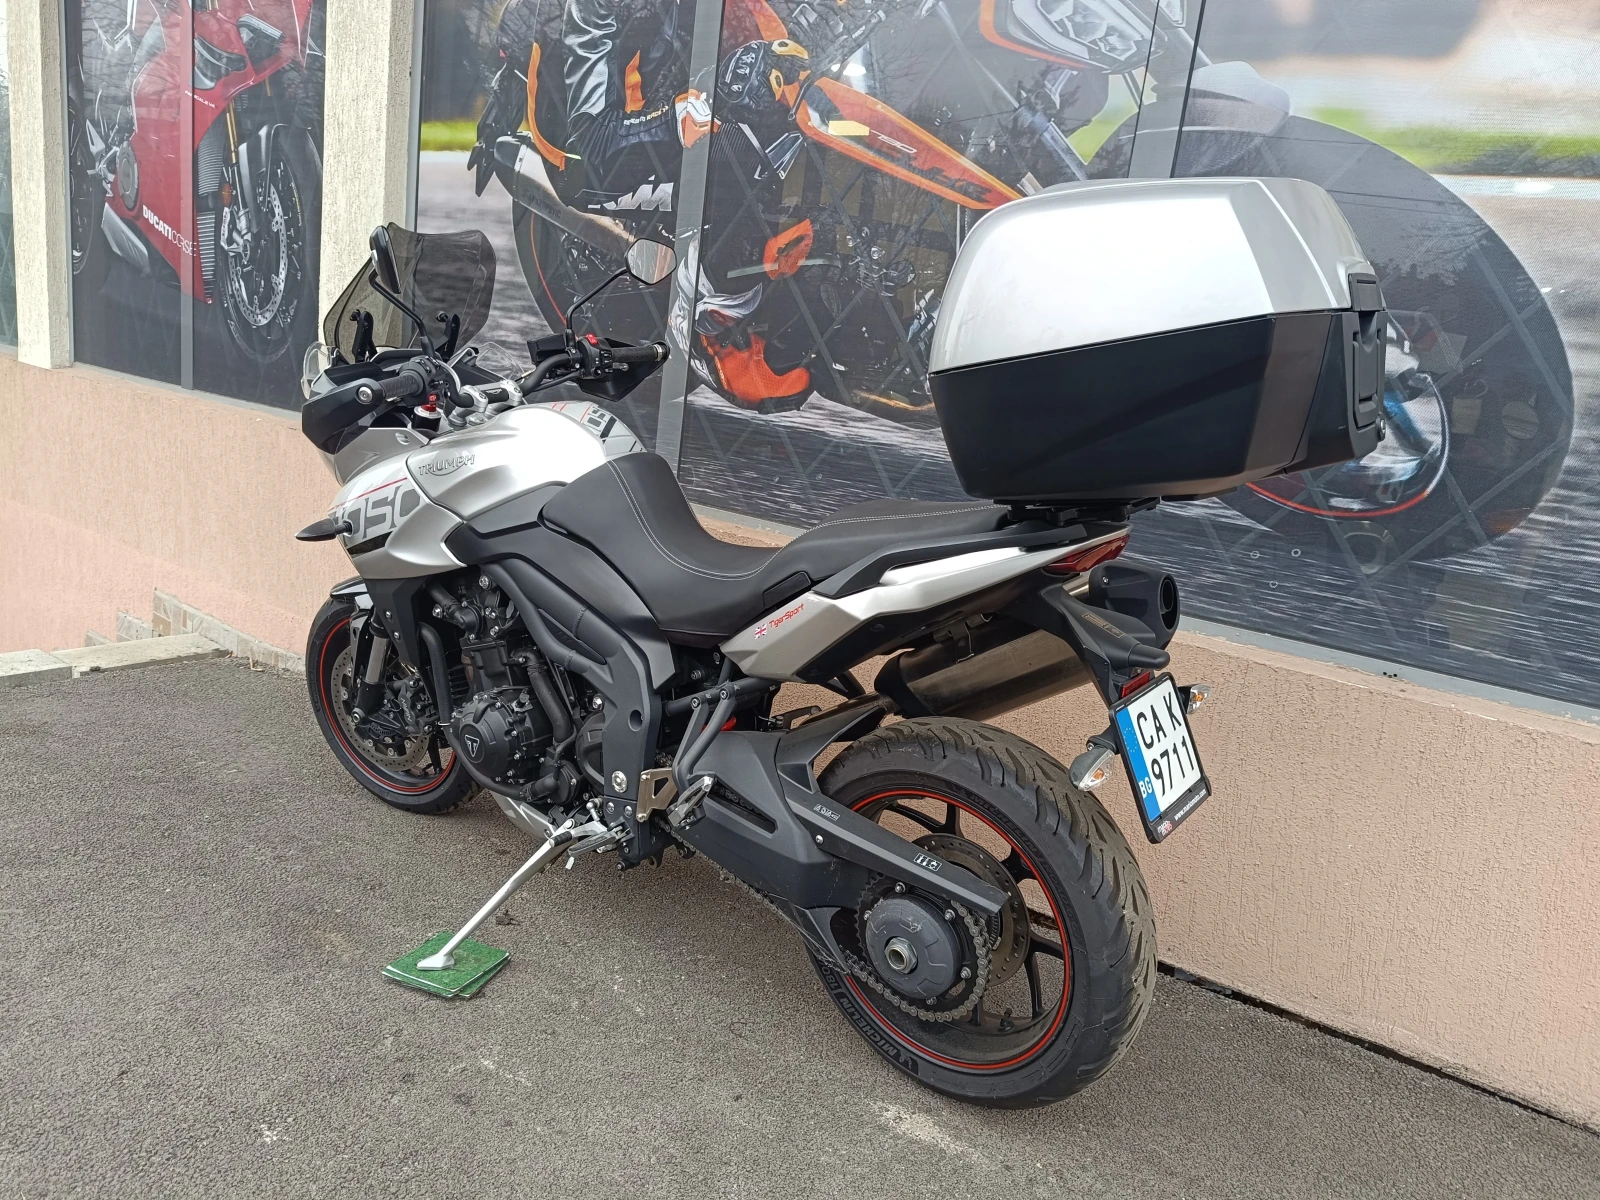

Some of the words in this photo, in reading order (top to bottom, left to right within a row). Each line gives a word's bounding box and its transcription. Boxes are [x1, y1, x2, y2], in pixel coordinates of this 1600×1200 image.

[418, 454, 476, 476] TRIUMPH
[1136, 704, 1167, 750] CA
[1163, 692, 1182, 731] K
[1138, 776, 1153, 799] BG
[1150, 735, 1195, 797] 9711
[841, 997, 898, 1056] MICHELIN
